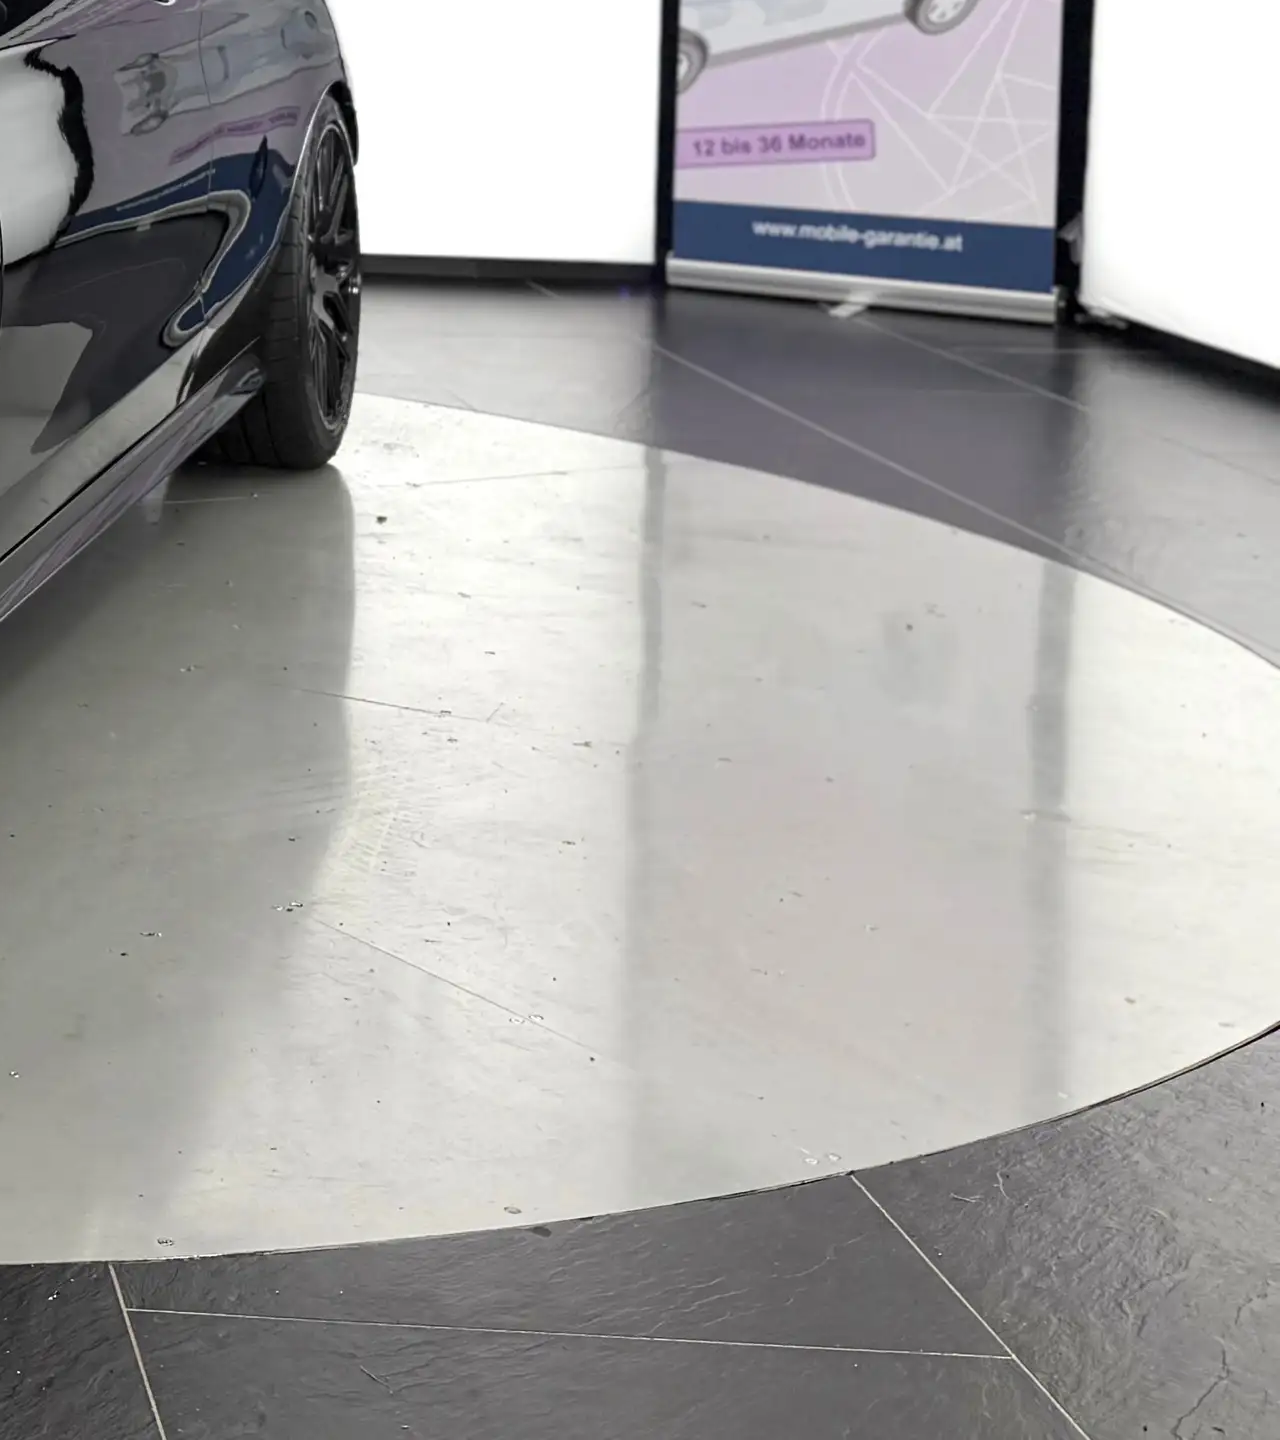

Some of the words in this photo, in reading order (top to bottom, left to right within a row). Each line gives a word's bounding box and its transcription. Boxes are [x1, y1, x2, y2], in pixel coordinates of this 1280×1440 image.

[692, 138, 715, 157] 12
[721, 135, 753, 155] bis
[758, 134, 783, 154] 36
[788, 131, 866, 153] Monate
[752, 218, 963, 253] www.mobile-garantie.at
